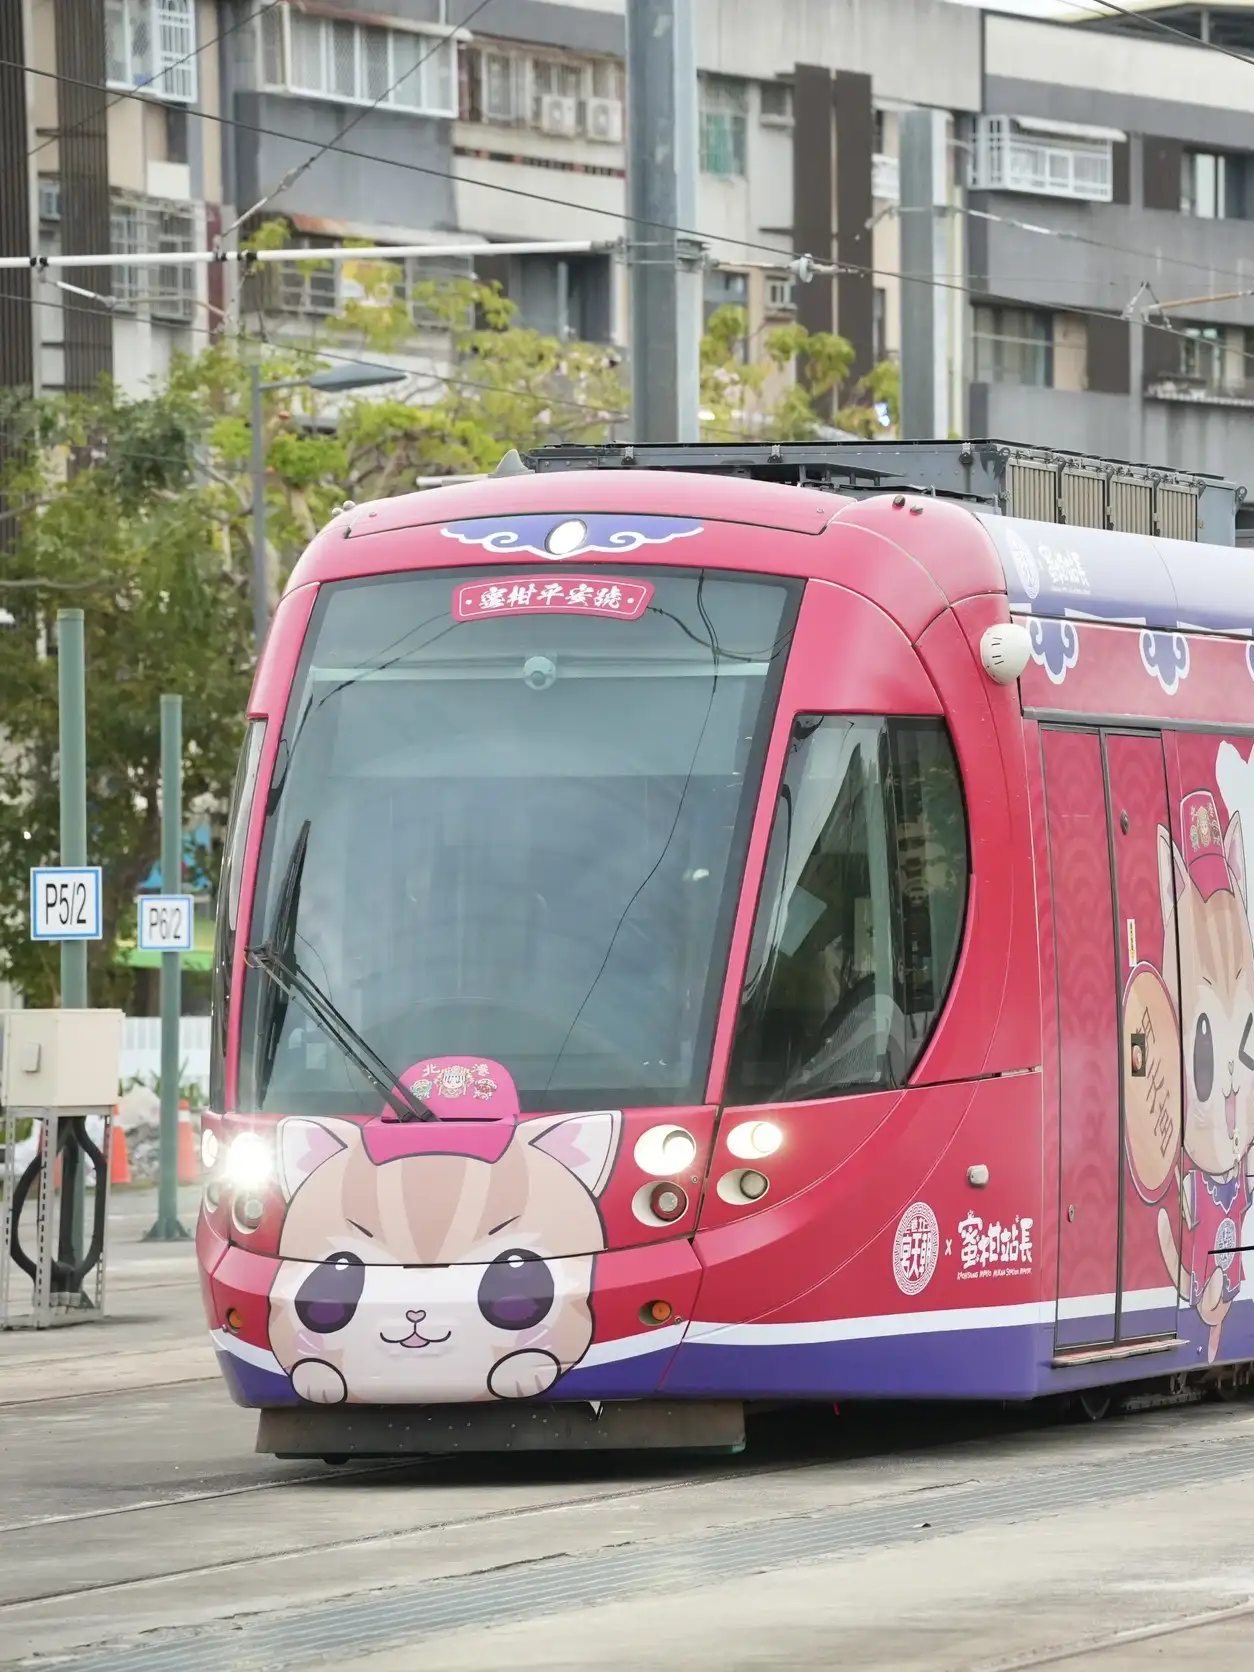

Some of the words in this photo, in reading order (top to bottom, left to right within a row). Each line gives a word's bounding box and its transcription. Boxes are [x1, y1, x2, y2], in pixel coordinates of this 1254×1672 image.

[45, 882, 87, 925] P5/2
[149, 908, 182, 940] P6/2
[957, 1212, 1034, 1269] 蜜柑站長
